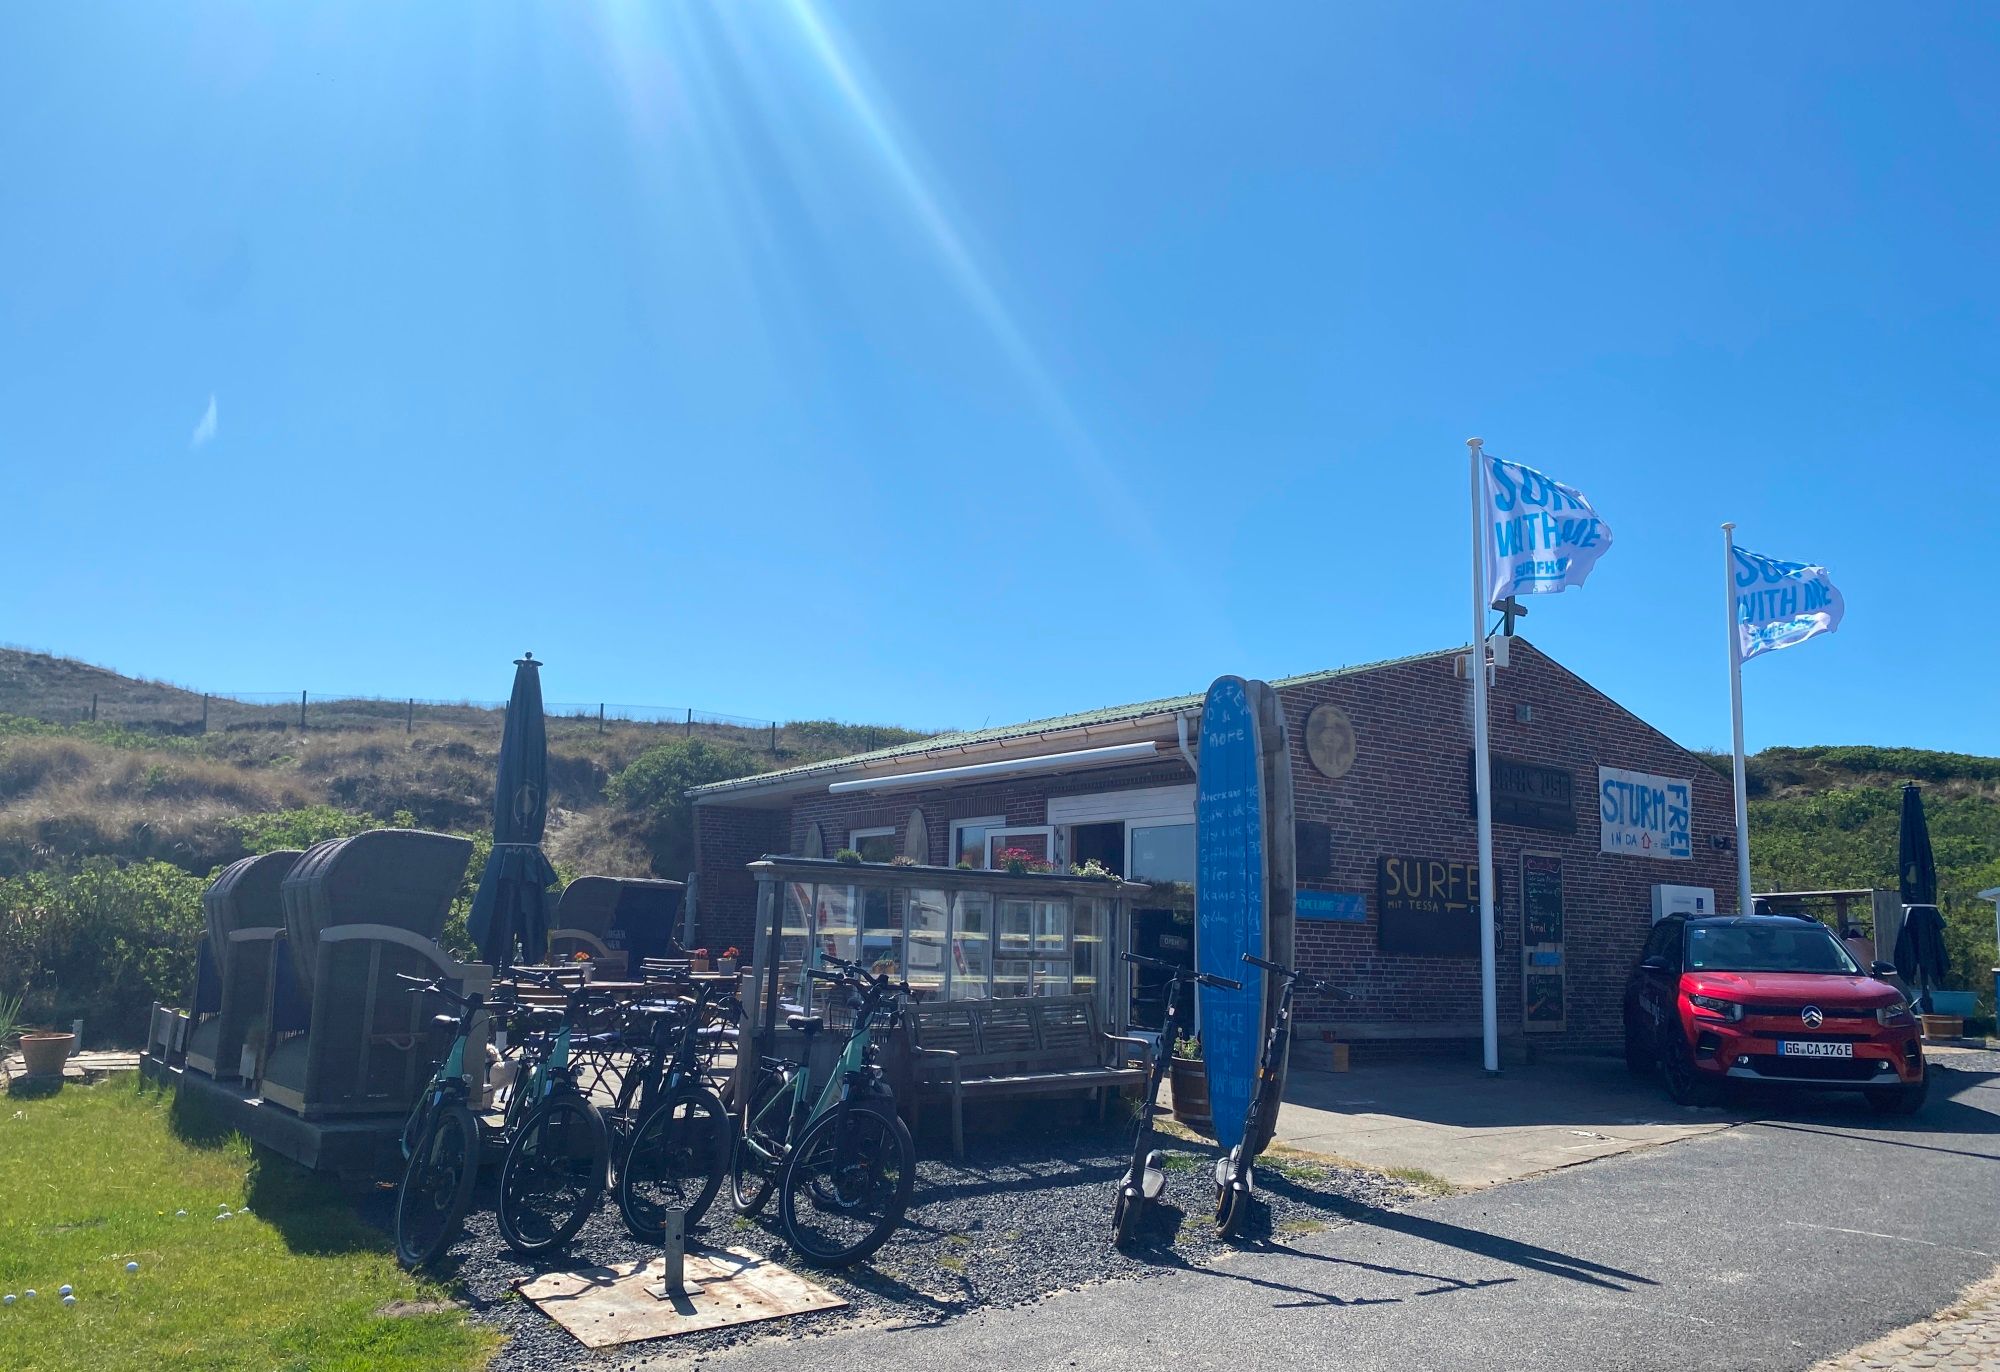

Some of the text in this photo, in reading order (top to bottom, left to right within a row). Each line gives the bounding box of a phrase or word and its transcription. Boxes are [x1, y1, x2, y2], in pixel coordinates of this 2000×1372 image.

[1496, 511, 1601, 557] WITH ME
[1533, 583, 1563, 593] SYL
[1737, 585, 1797, 623] WITH
[1602, 779, 1689, 857] STURM FREI
[1611, 832, 1638, 847] IN DA
[1386, 859, 1496, 902] SURFE
[1388, 900, 1402, 909] MIT
[1409, 900, 1438, 912] TESSA
[1785, 1043, 1800, 1054] GG
[1807, 1044, 1821, 1055] CA
